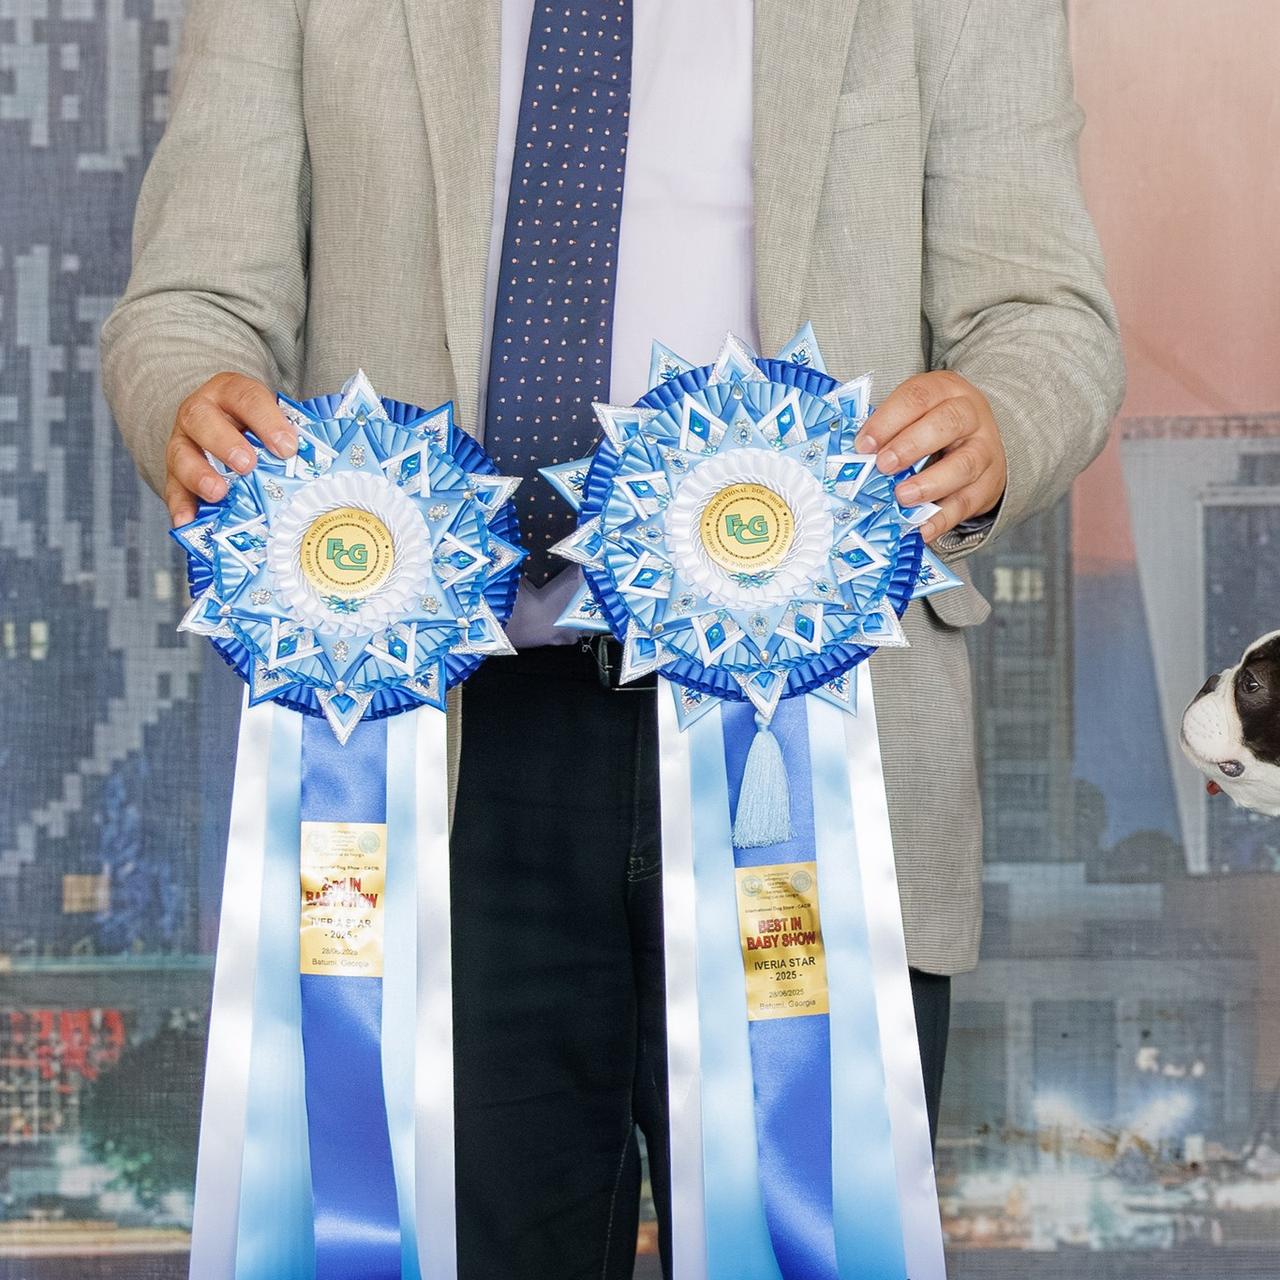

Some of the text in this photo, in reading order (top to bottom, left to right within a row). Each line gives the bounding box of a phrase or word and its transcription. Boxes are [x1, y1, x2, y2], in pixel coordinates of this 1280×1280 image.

[708, 488, 747, 519] INTERNATIONAL
[768, 494, 783, 509] SHOW
[310, 513, 386, 541] INTERNATIONAL DOG SHOW
[349, 877, 362, 892] IN
[758, 916, 802, 934] BEST IN
[746, 931, 816, 951] BABY SHOW
[754, 956, 816, 971] IVERIA STAR
[775, 971, 797, 981] 2025
[788, 999, 816, 1008] Georgia
